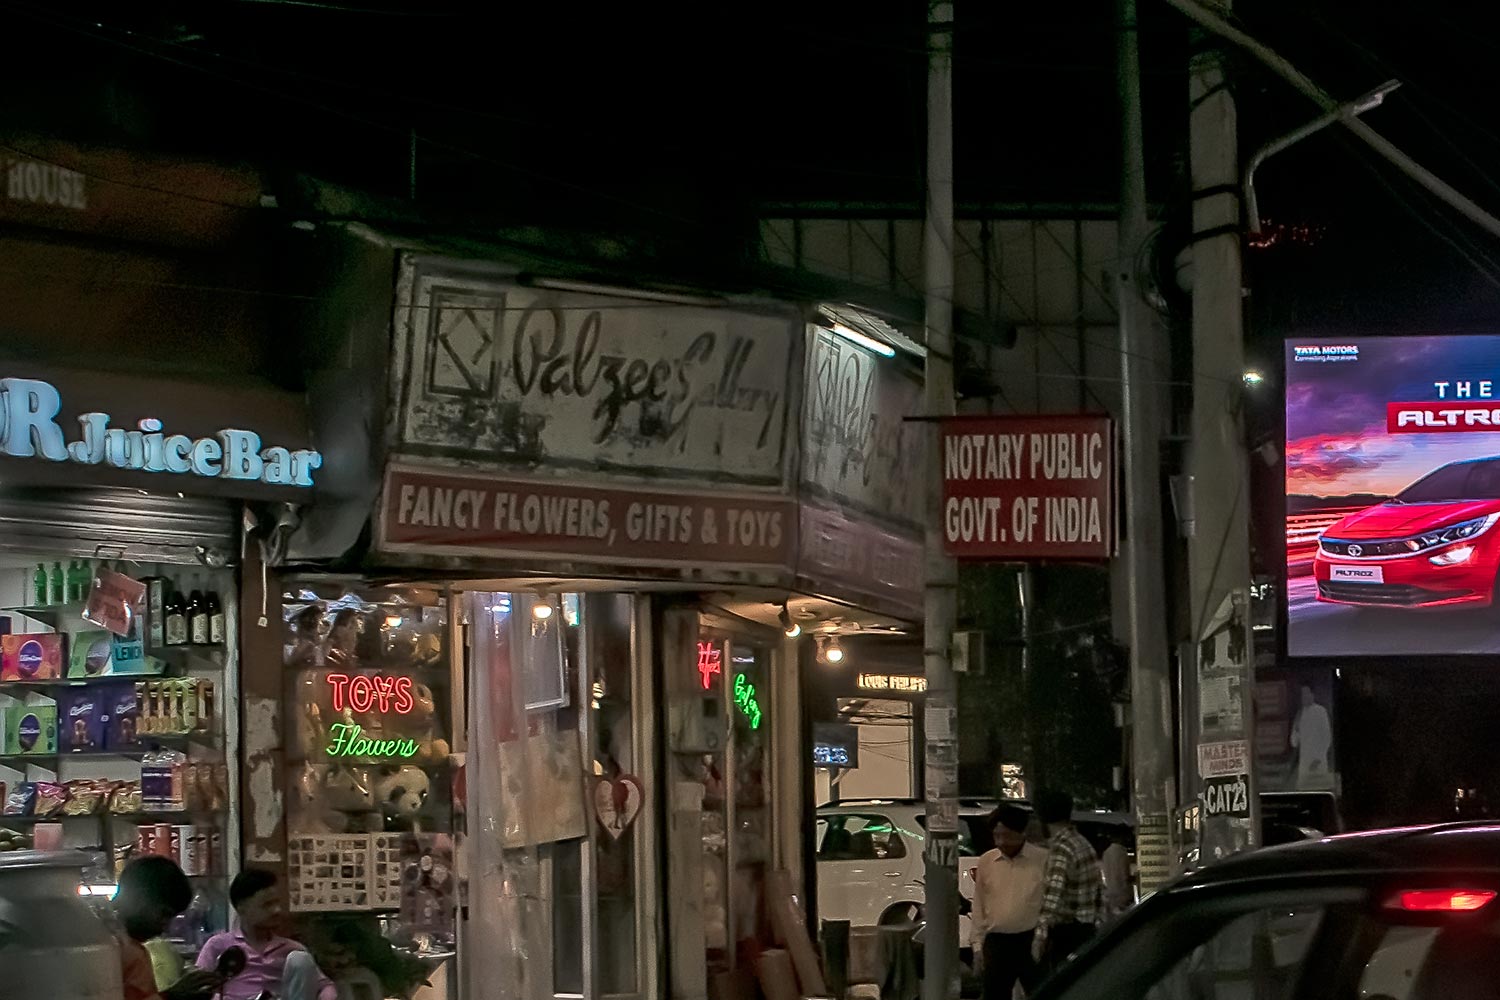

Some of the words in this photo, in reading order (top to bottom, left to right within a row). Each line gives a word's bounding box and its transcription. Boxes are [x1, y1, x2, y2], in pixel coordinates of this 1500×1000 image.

[7, 160, 87, 209] HOUSE
[1294, 346, 1321, 355] TATA
[1322, 345, 1359, 355] MOTORS
[1434, 381, 1493, 399] THE
[945, 434, 1024, 480] NOTARY
[1030, 432, 1102, 479] PUBLIC
[398, 484, 487, 530] FANCY
[494, 491, 618, 547] FLOWERS,
[626, 502, 693, 545] GIFTS
[702, 508, 718, 545] &
[726, 508, 783, 549] TOYS
[945, 496, 1006, 543] GOVT.
[1012, 496, 1039, 542] OF
[1045, 496, 1102, 542] INDIA
[1335, 569, 1374, 577] ALTROZ
[326, 673, 415, 715] TOYS
[325, 722, 420, 758] Flowers
